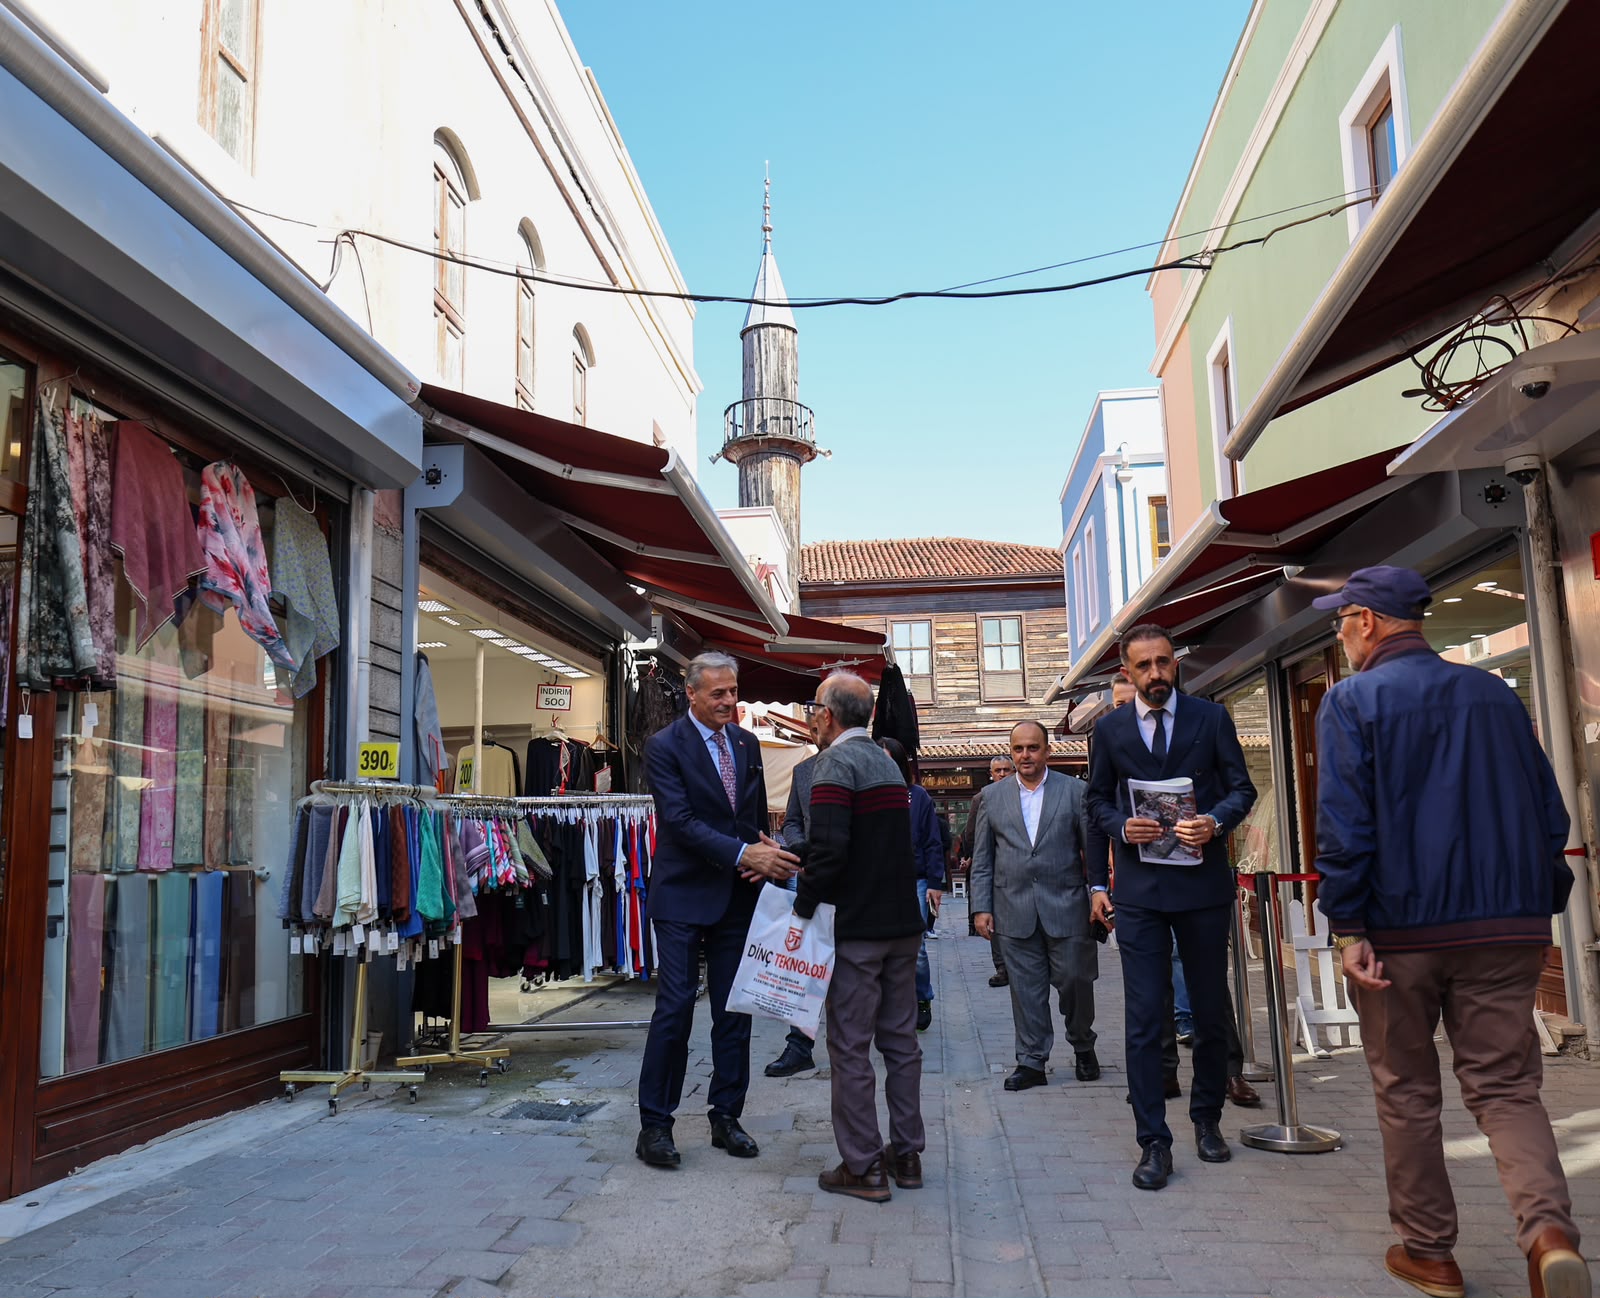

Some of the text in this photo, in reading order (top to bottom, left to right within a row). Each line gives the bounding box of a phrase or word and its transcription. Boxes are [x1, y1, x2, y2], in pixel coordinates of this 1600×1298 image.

[544, 697, 566, 707] 500
[747, 943, 828, 980] DİNÇ TEKNOLOJİ
